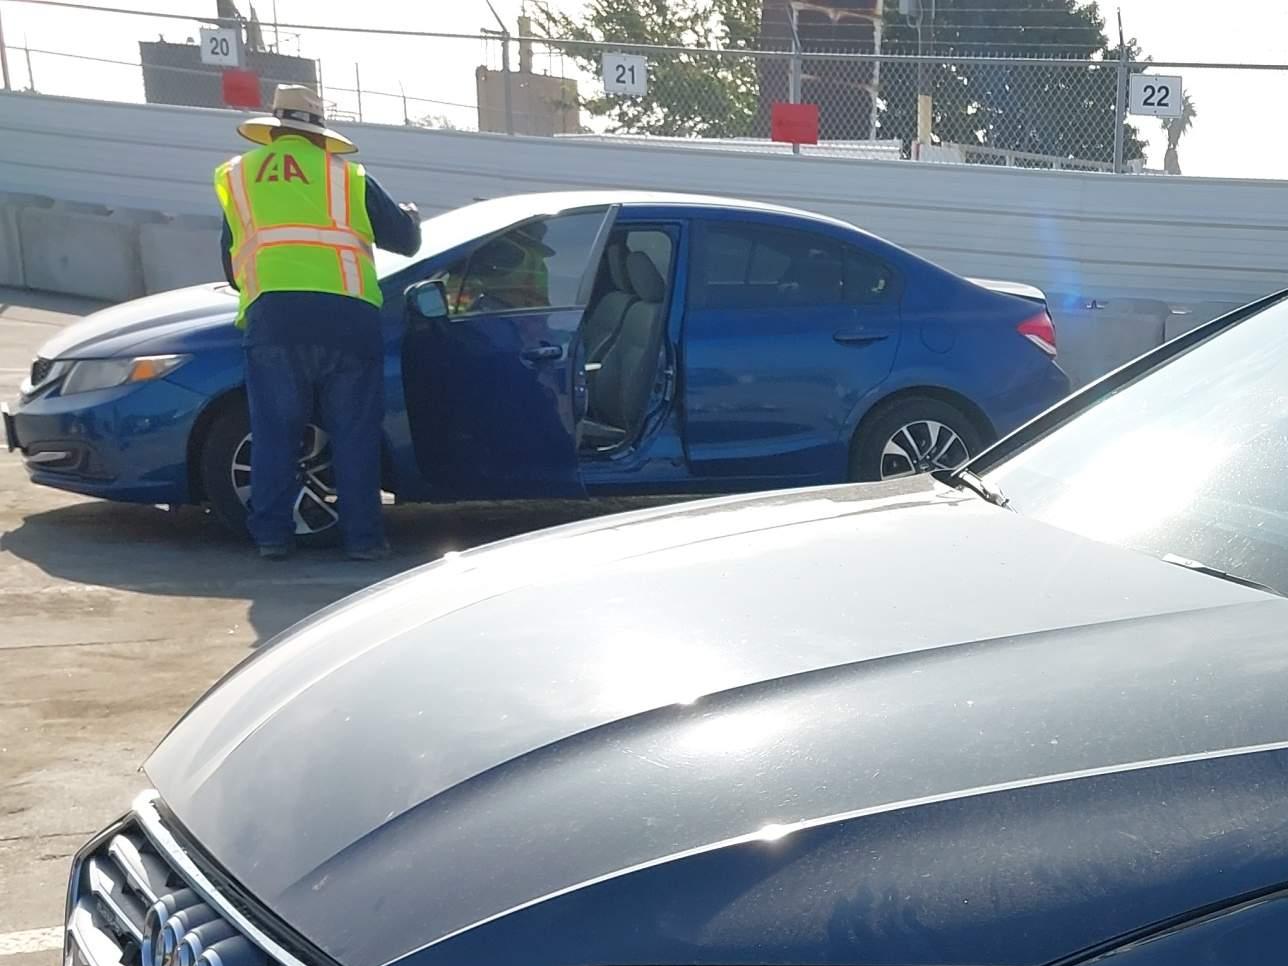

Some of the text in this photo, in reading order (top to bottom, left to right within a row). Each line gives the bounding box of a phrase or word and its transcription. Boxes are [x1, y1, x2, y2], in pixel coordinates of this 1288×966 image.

[209, 37, 230, 56] 20
[615, 64, 635, 84] 21
[1142, 85, 1169, 107] 22
